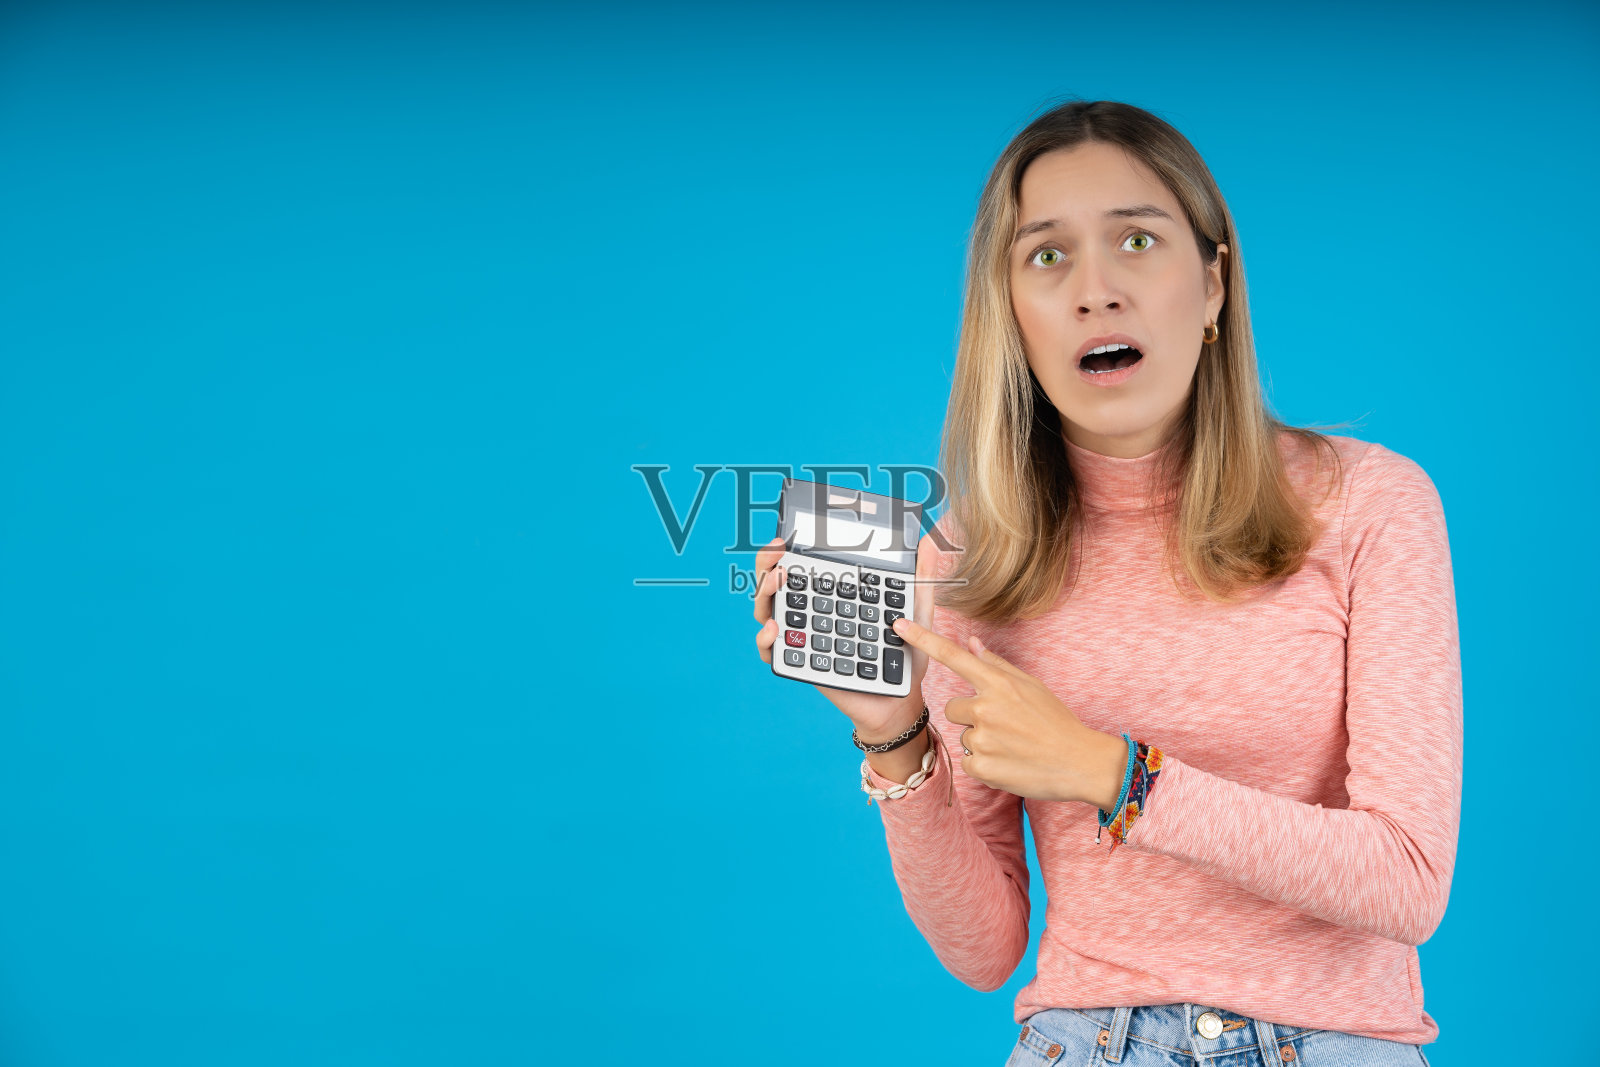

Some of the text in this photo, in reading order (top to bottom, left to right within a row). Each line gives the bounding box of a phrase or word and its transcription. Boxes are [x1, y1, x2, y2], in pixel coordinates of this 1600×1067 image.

[819, 580, 832, 590] MR
[864, 588, 879, 598] M+
[821, 600, 828, 609] 7
[844, 604, 851, 614] 8
[867, 608, 874, 618] 9
[820, 619, 828, 628] 4
[843, 622, 850, 632] 5
[866, 627, 873, 637] 6
[821, 638, 825, 648] 1
[843, 642, 850, 652] 2
[866, 646, 873, 656] 3
[792, 653, 799, 662] 0
[816, 656, 829, 667] 00
